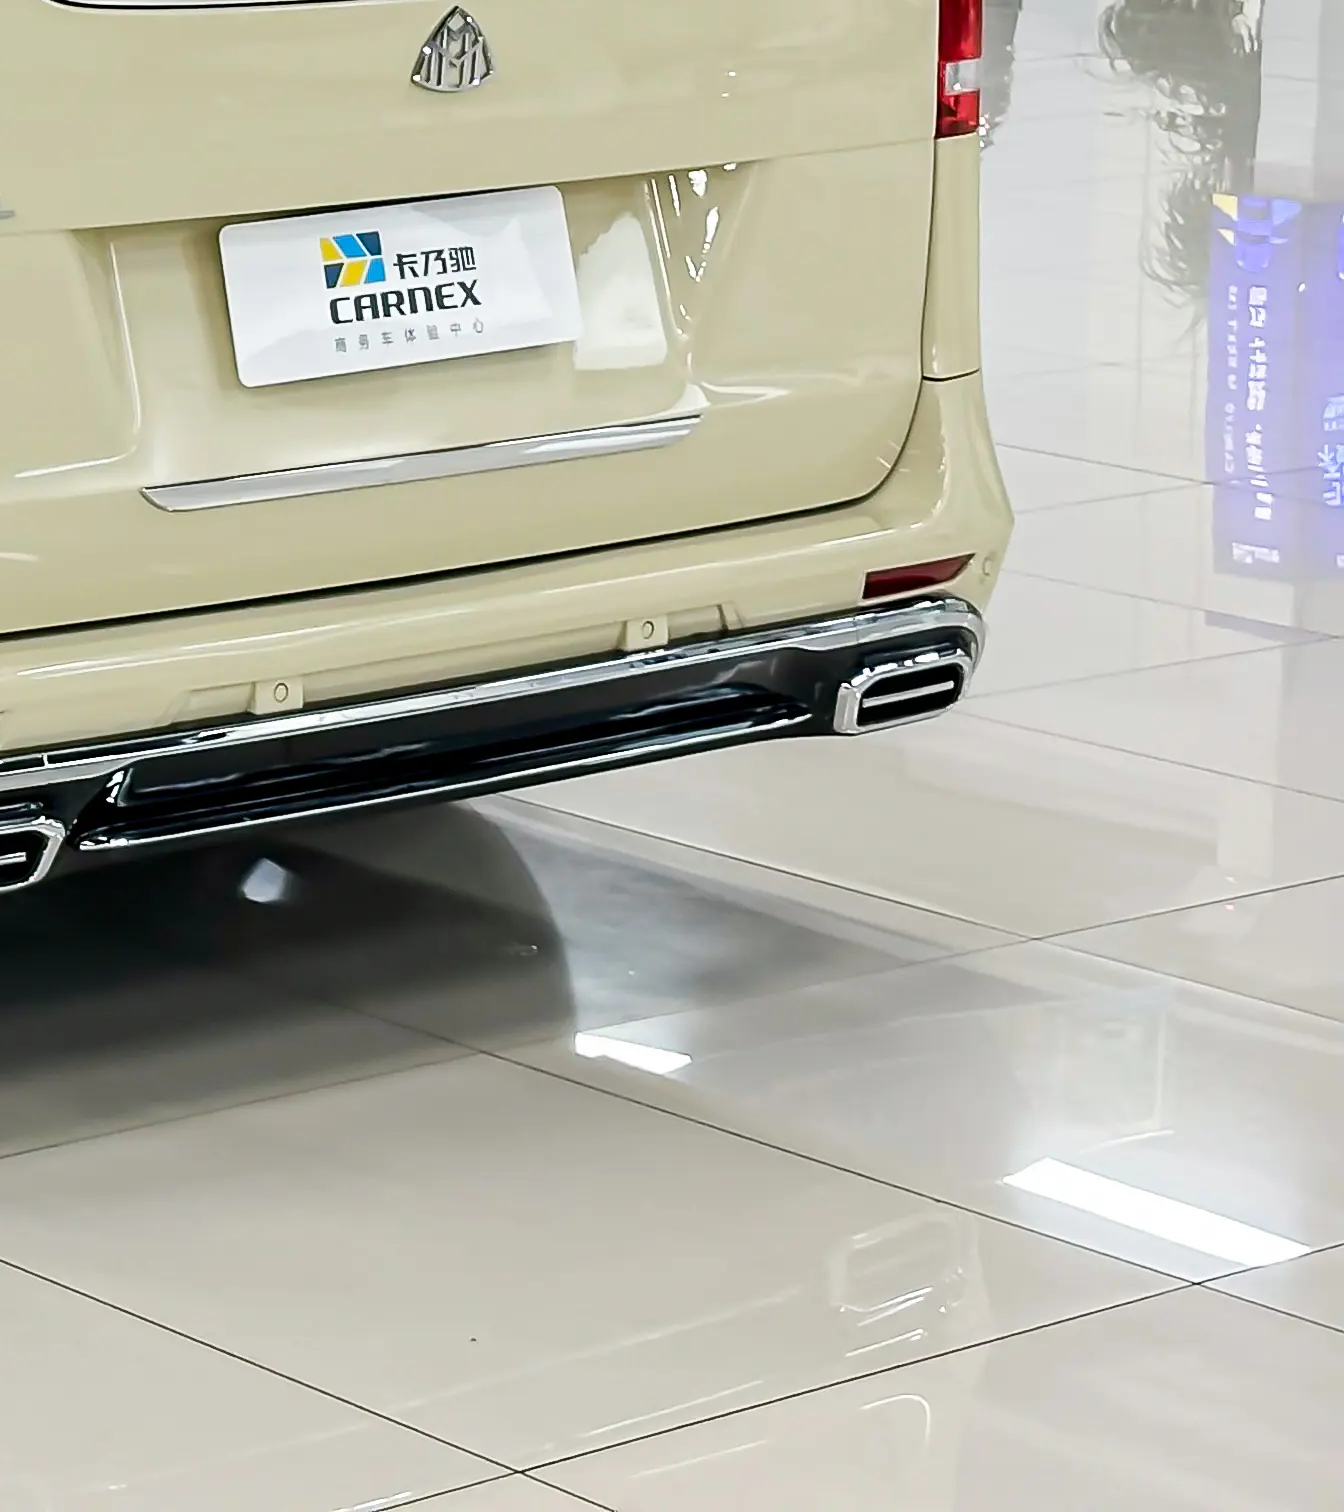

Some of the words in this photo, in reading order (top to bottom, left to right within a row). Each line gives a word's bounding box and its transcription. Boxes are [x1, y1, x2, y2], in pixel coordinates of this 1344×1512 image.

[393, 246, 477, 280] 卡乃驰
[329, 279, 482, 324] CARNEX
